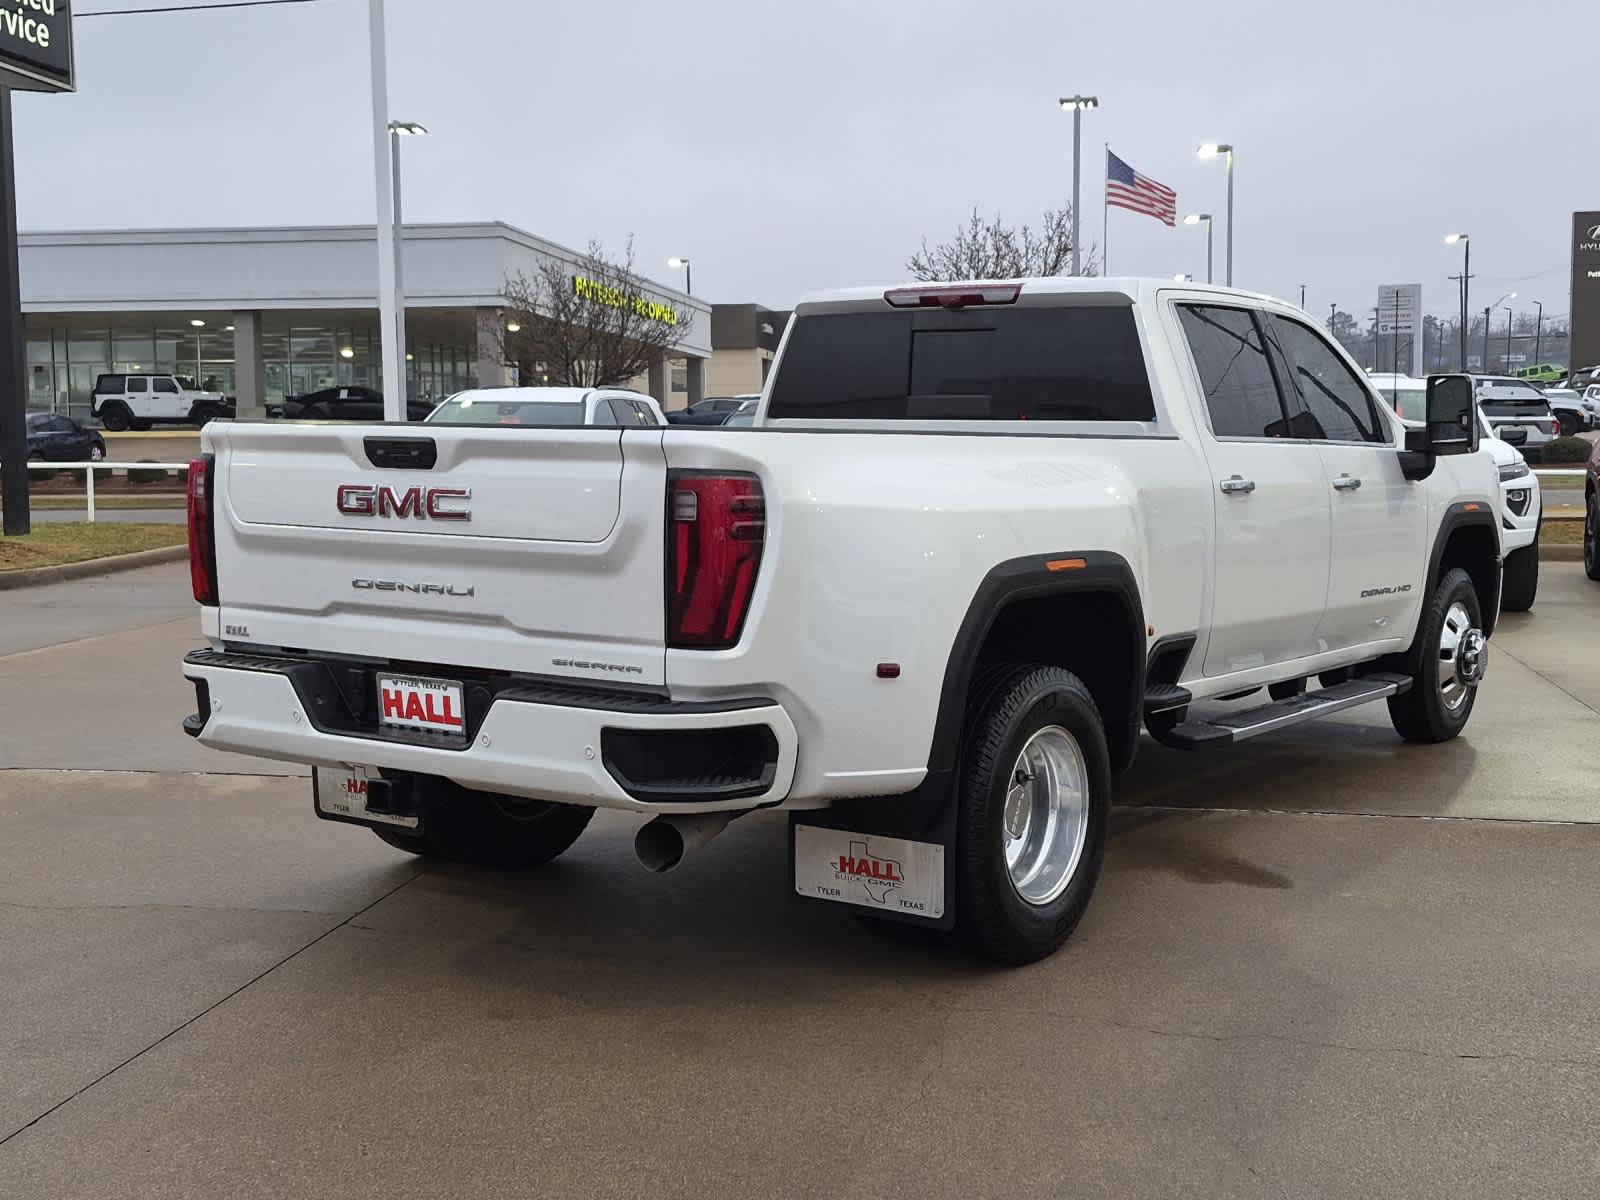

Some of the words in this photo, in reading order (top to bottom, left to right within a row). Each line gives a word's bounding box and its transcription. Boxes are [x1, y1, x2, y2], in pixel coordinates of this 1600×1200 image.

[337, 483, 472, 522] GMC
[352, 579, 475, 597] DENALI
[552, 659, 642, 674] SIERRA
[382, 688, 462, 726] HALL
[346, 778, 368, 793] HA
[839, 855, 901, 881] HALL
[817, 886, 841, 896] TYLER
[900, 900, 924, 911] TEXAS
